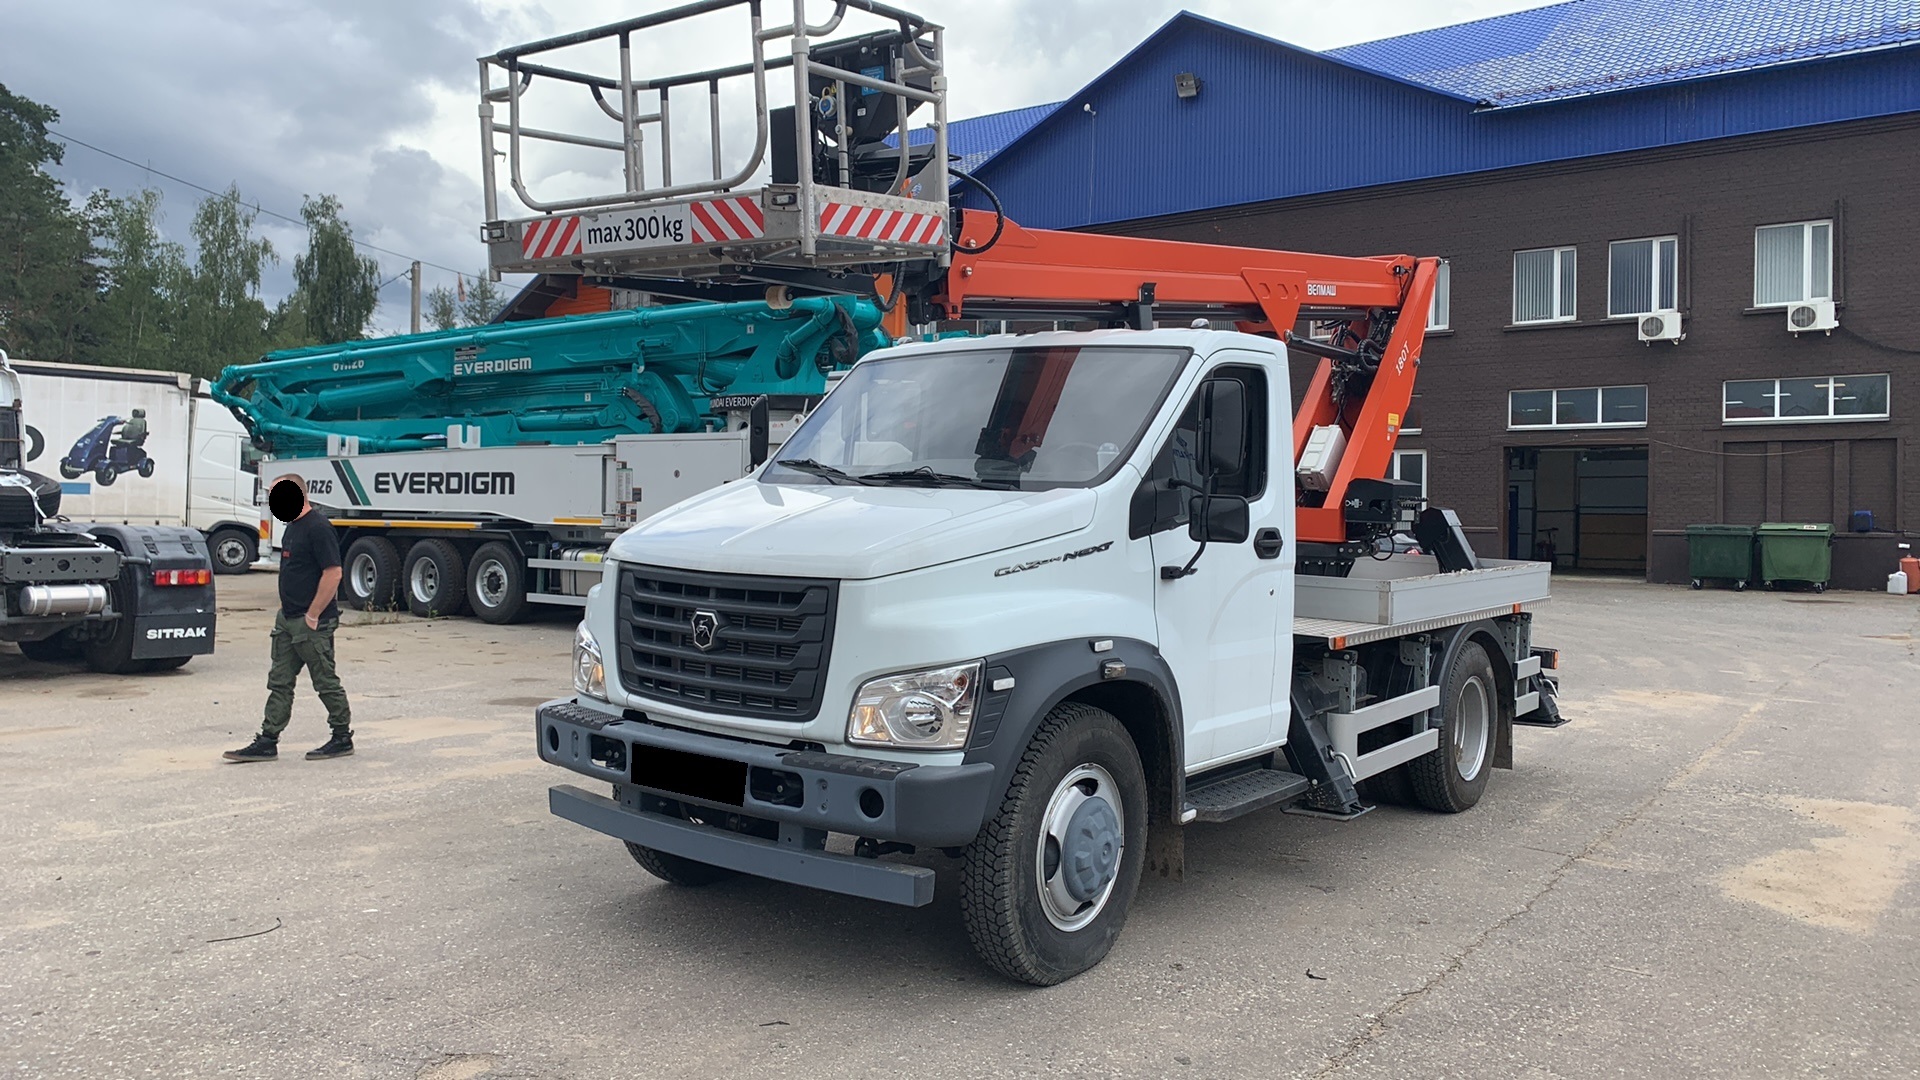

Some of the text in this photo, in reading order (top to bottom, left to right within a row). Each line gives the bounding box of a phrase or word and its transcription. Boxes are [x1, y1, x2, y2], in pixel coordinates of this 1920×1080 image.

[588, 215, 684, 245] max 300 kg
[453, 357, 532, 376] EVERDIGM
[374, 471, 515, 495] EVERDIGM
[1062, 541, 1115, 562] NEXT
[146, 626, 207, 640] SITRAK
